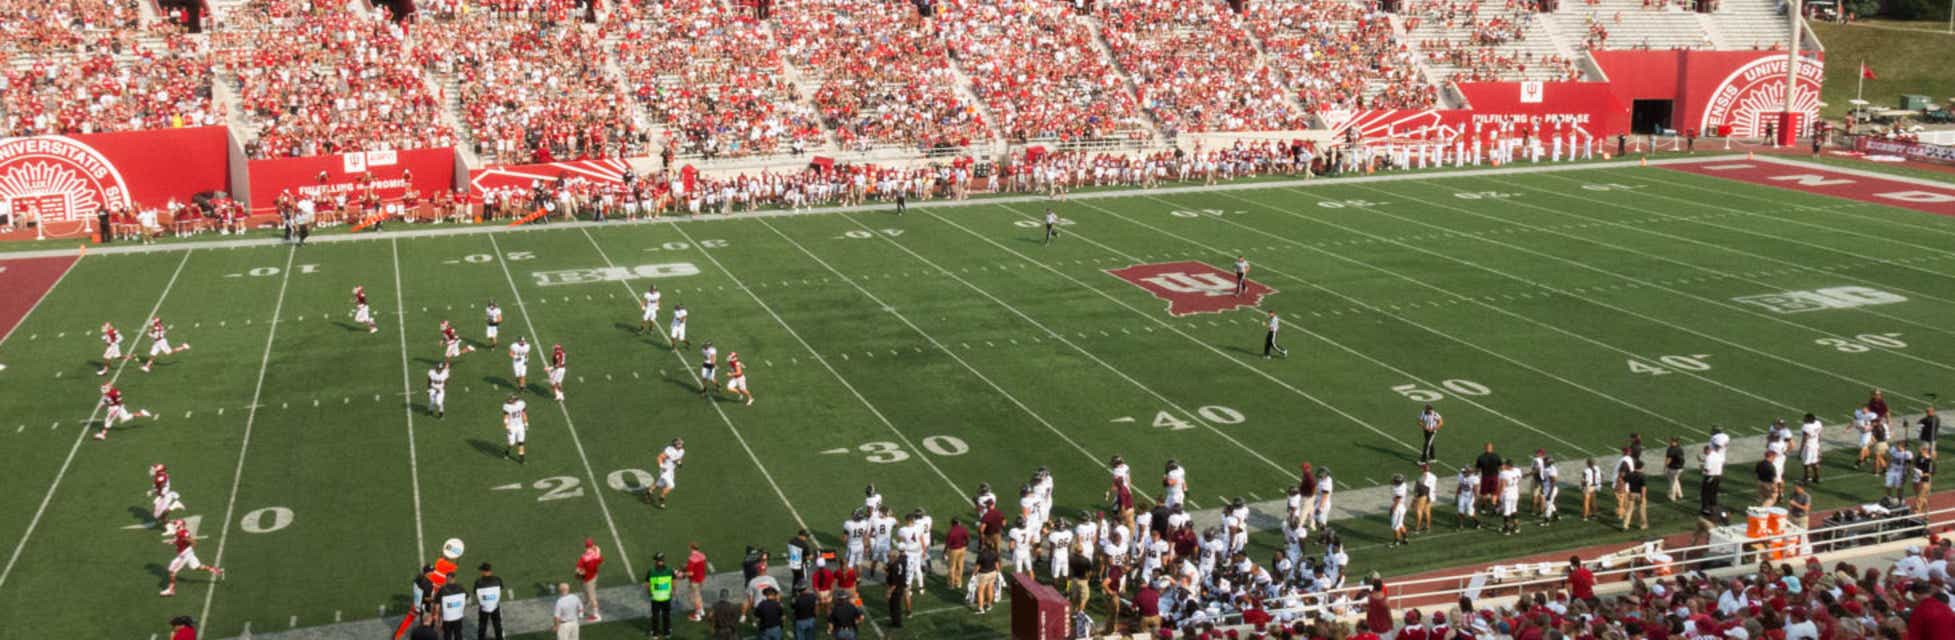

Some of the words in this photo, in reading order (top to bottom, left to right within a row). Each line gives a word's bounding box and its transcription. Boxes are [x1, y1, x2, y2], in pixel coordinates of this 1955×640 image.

[370, 178, 407, 190] PROMIS
[1392, 378, 1492, 402] 50
[1151, 404, 1246, 431] 40
[859, 434, 970, 464] 30
[533, 468, 655, 502] 20
[879, 524, 886, 535] 8
